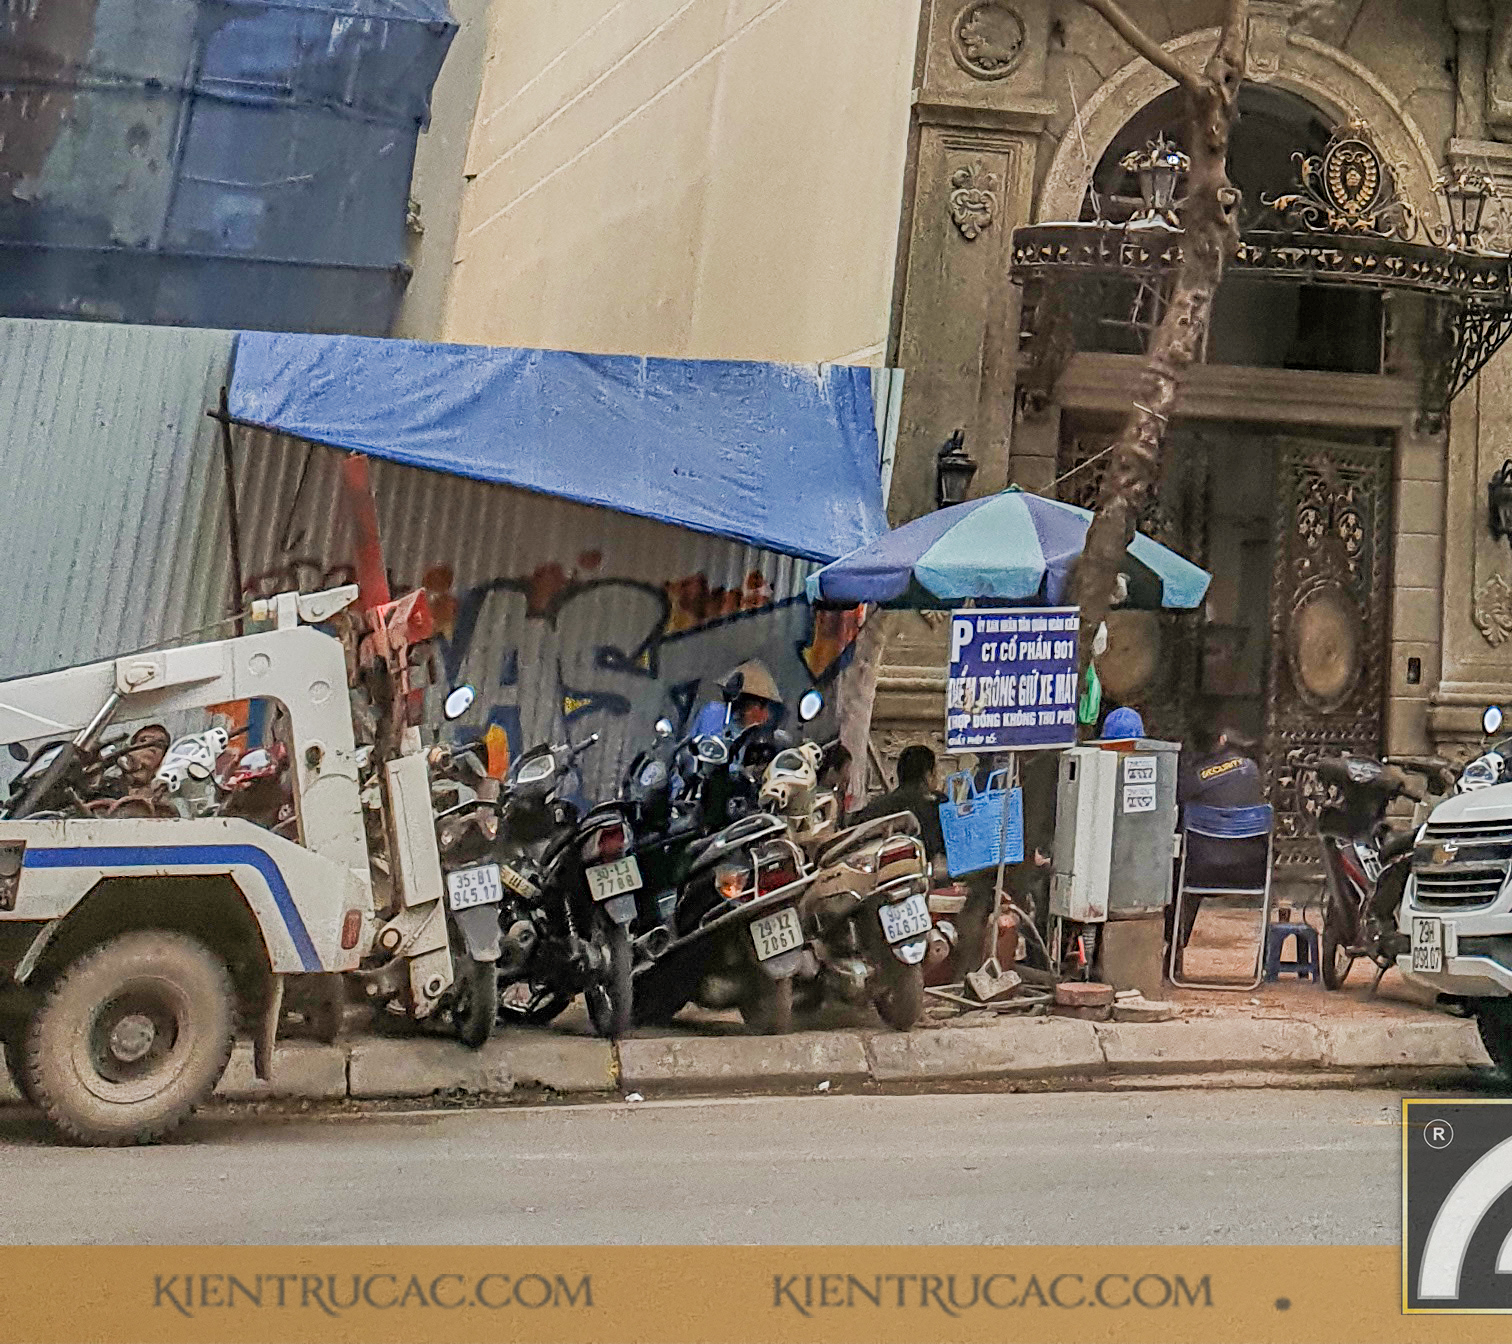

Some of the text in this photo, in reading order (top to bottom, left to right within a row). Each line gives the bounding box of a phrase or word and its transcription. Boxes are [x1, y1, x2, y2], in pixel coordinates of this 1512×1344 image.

[951, 620, 974, 662] P
[982, 643, 998, 661] CT
[1054, 640, 1073, 659] 901
